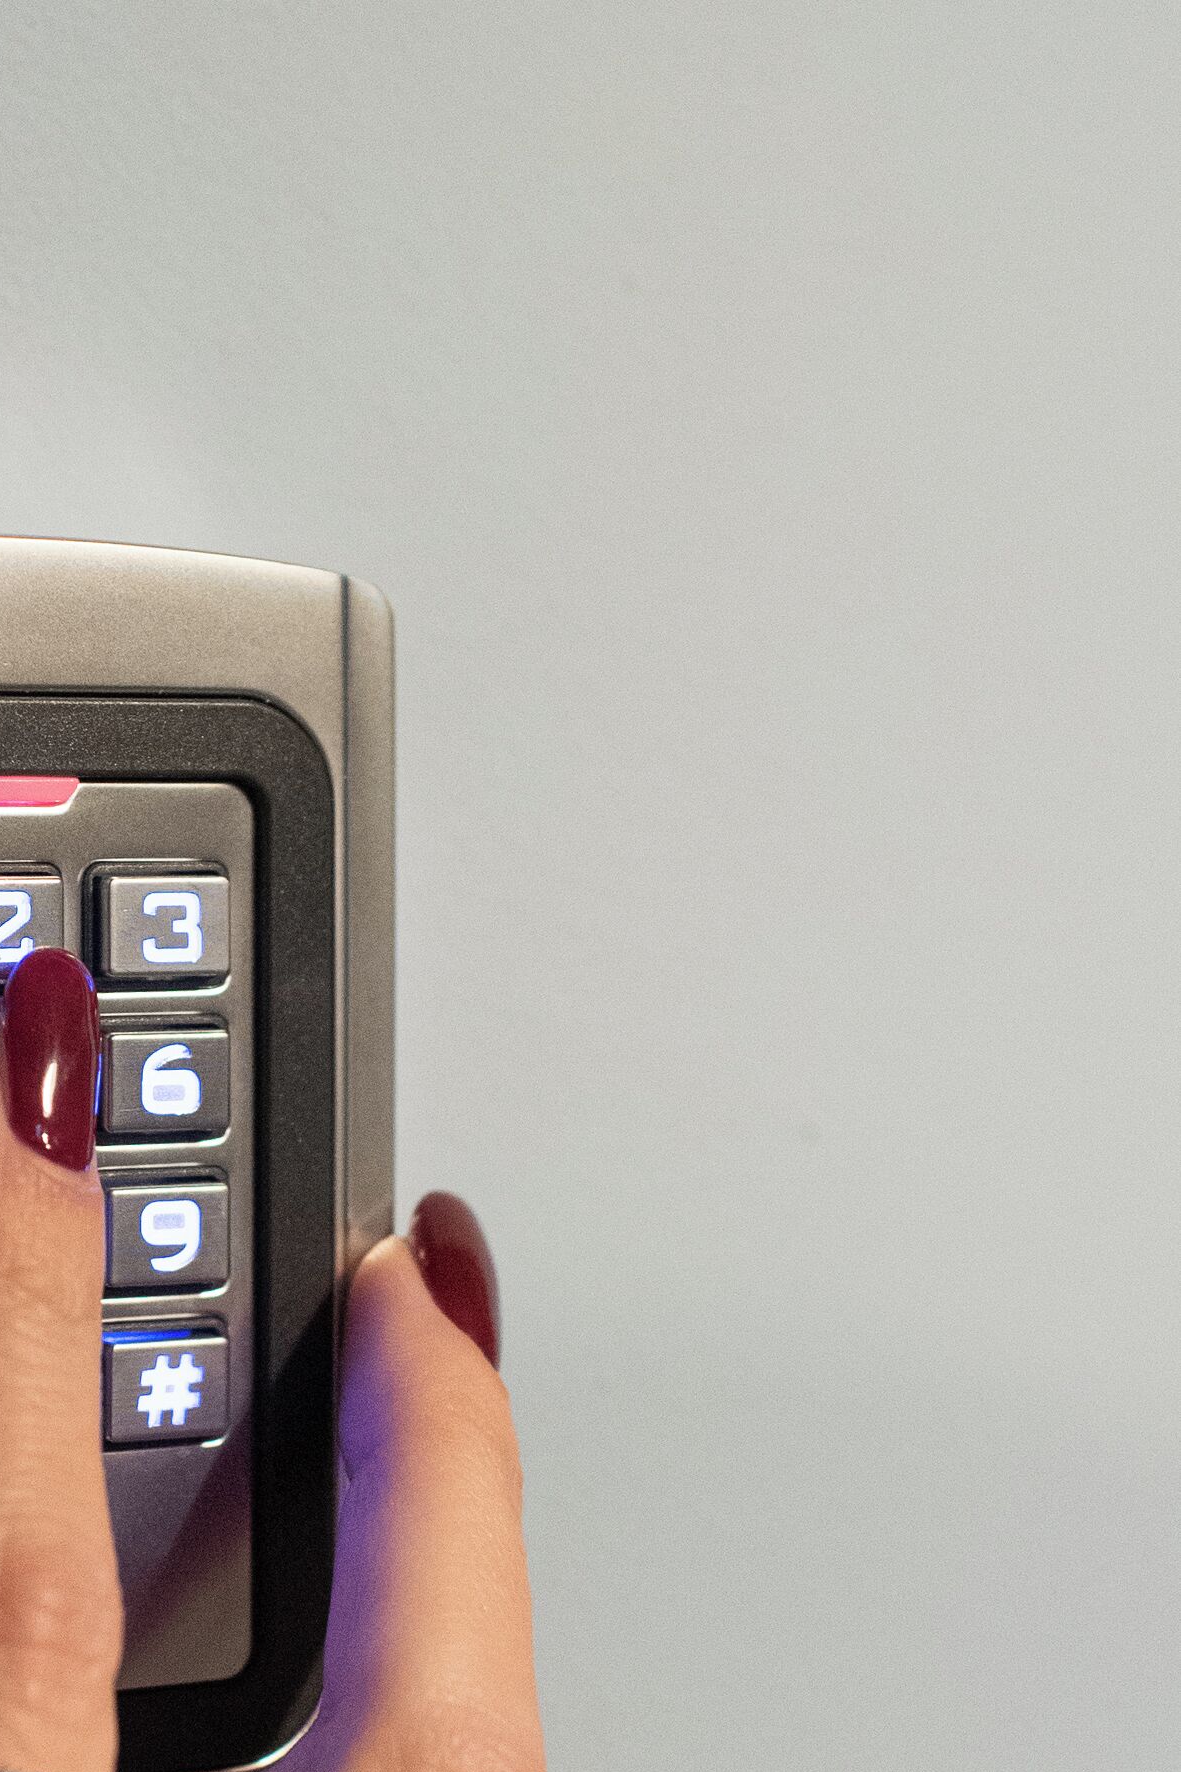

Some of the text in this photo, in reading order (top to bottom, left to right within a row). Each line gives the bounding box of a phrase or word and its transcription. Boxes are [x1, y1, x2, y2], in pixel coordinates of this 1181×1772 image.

[142, 890, 206, 966] 3
[141, 1043, 202, 1117] 6
[140, 1199, 202, 1273] 9
[136, 1352, 205, 1428] #
